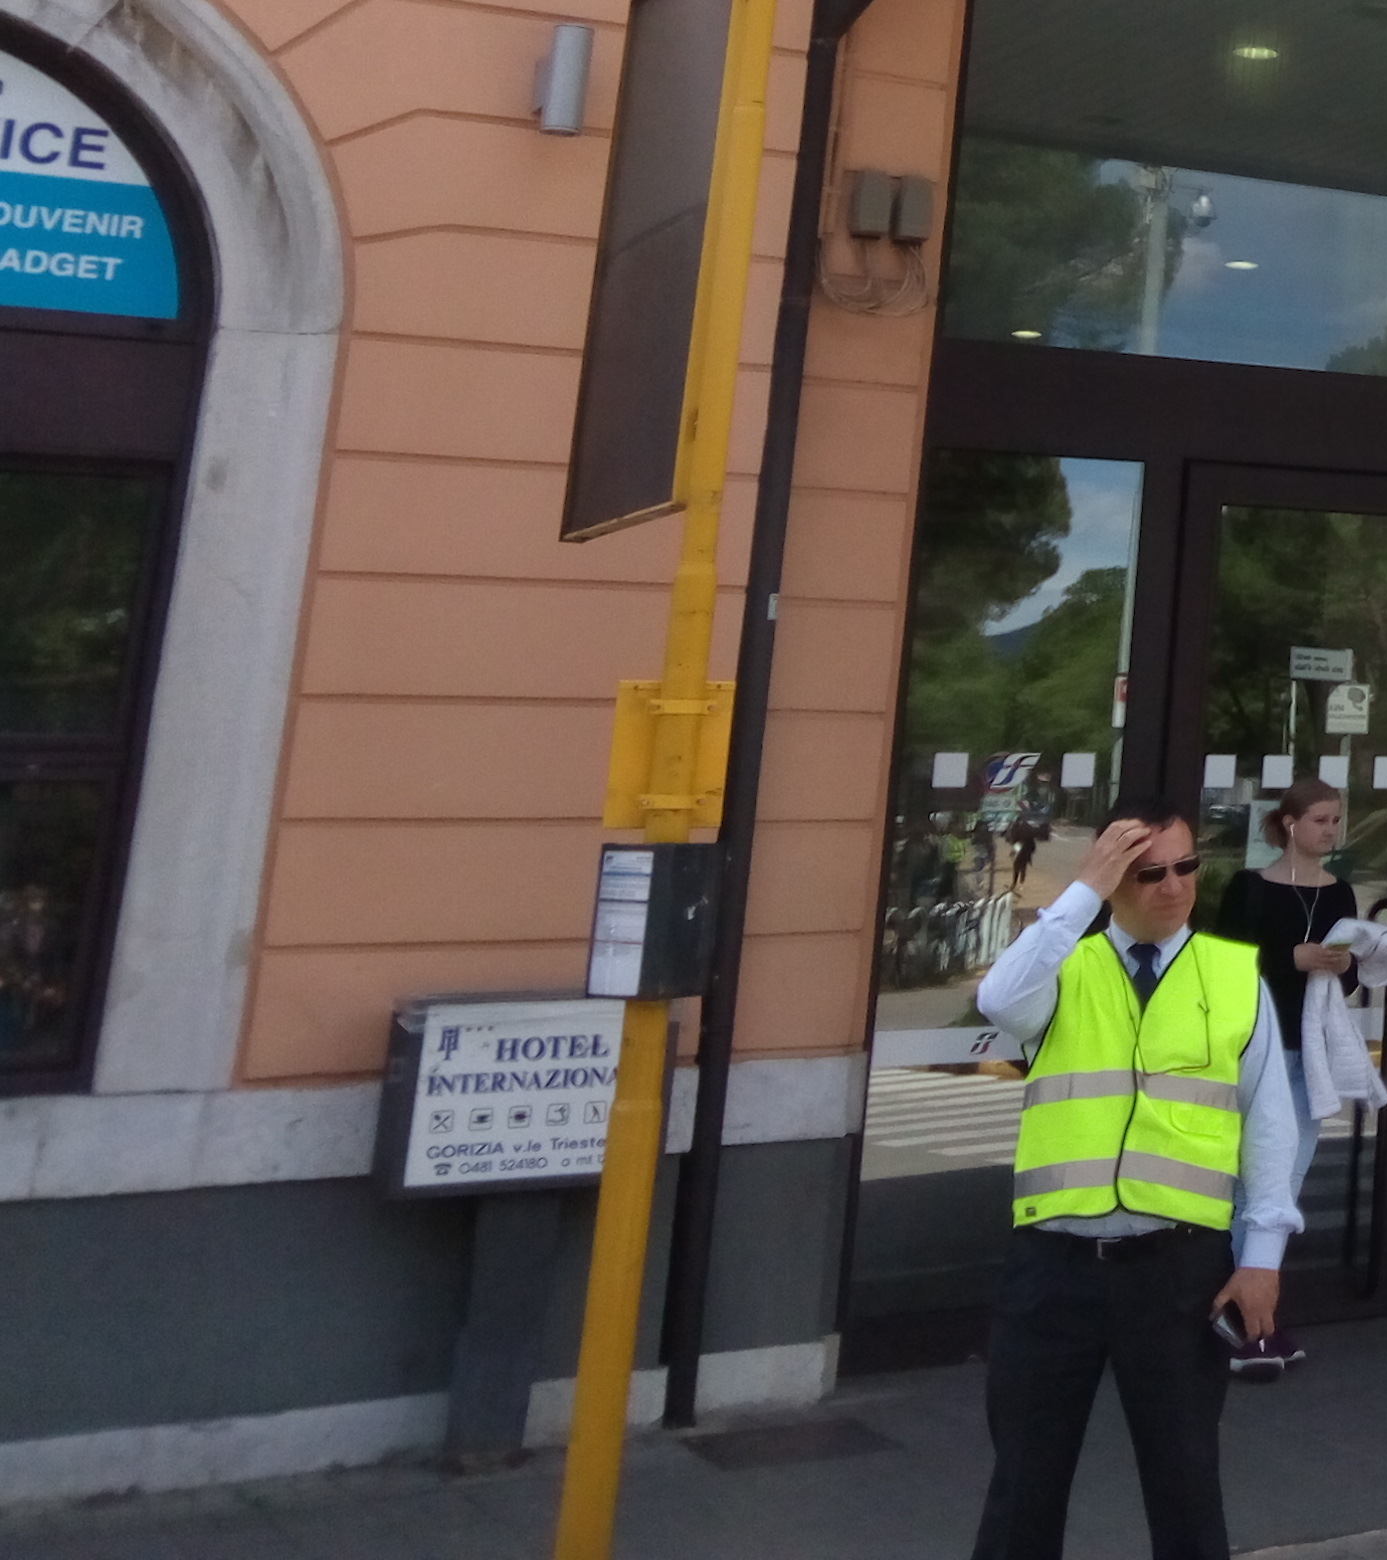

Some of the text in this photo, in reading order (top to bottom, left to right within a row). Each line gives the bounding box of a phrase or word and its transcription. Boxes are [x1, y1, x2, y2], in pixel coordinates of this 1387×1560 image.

[0, 119, 109, 170] ICE
[0, 248, 123, 281] ADGET
[495, 1034, 610, 1062] HOTEL
[426, 1142, 504, 1159] GORIZIA
[513, 1140, 541, 1153] v.le
[458, 1160, 493, 1174] 0481
